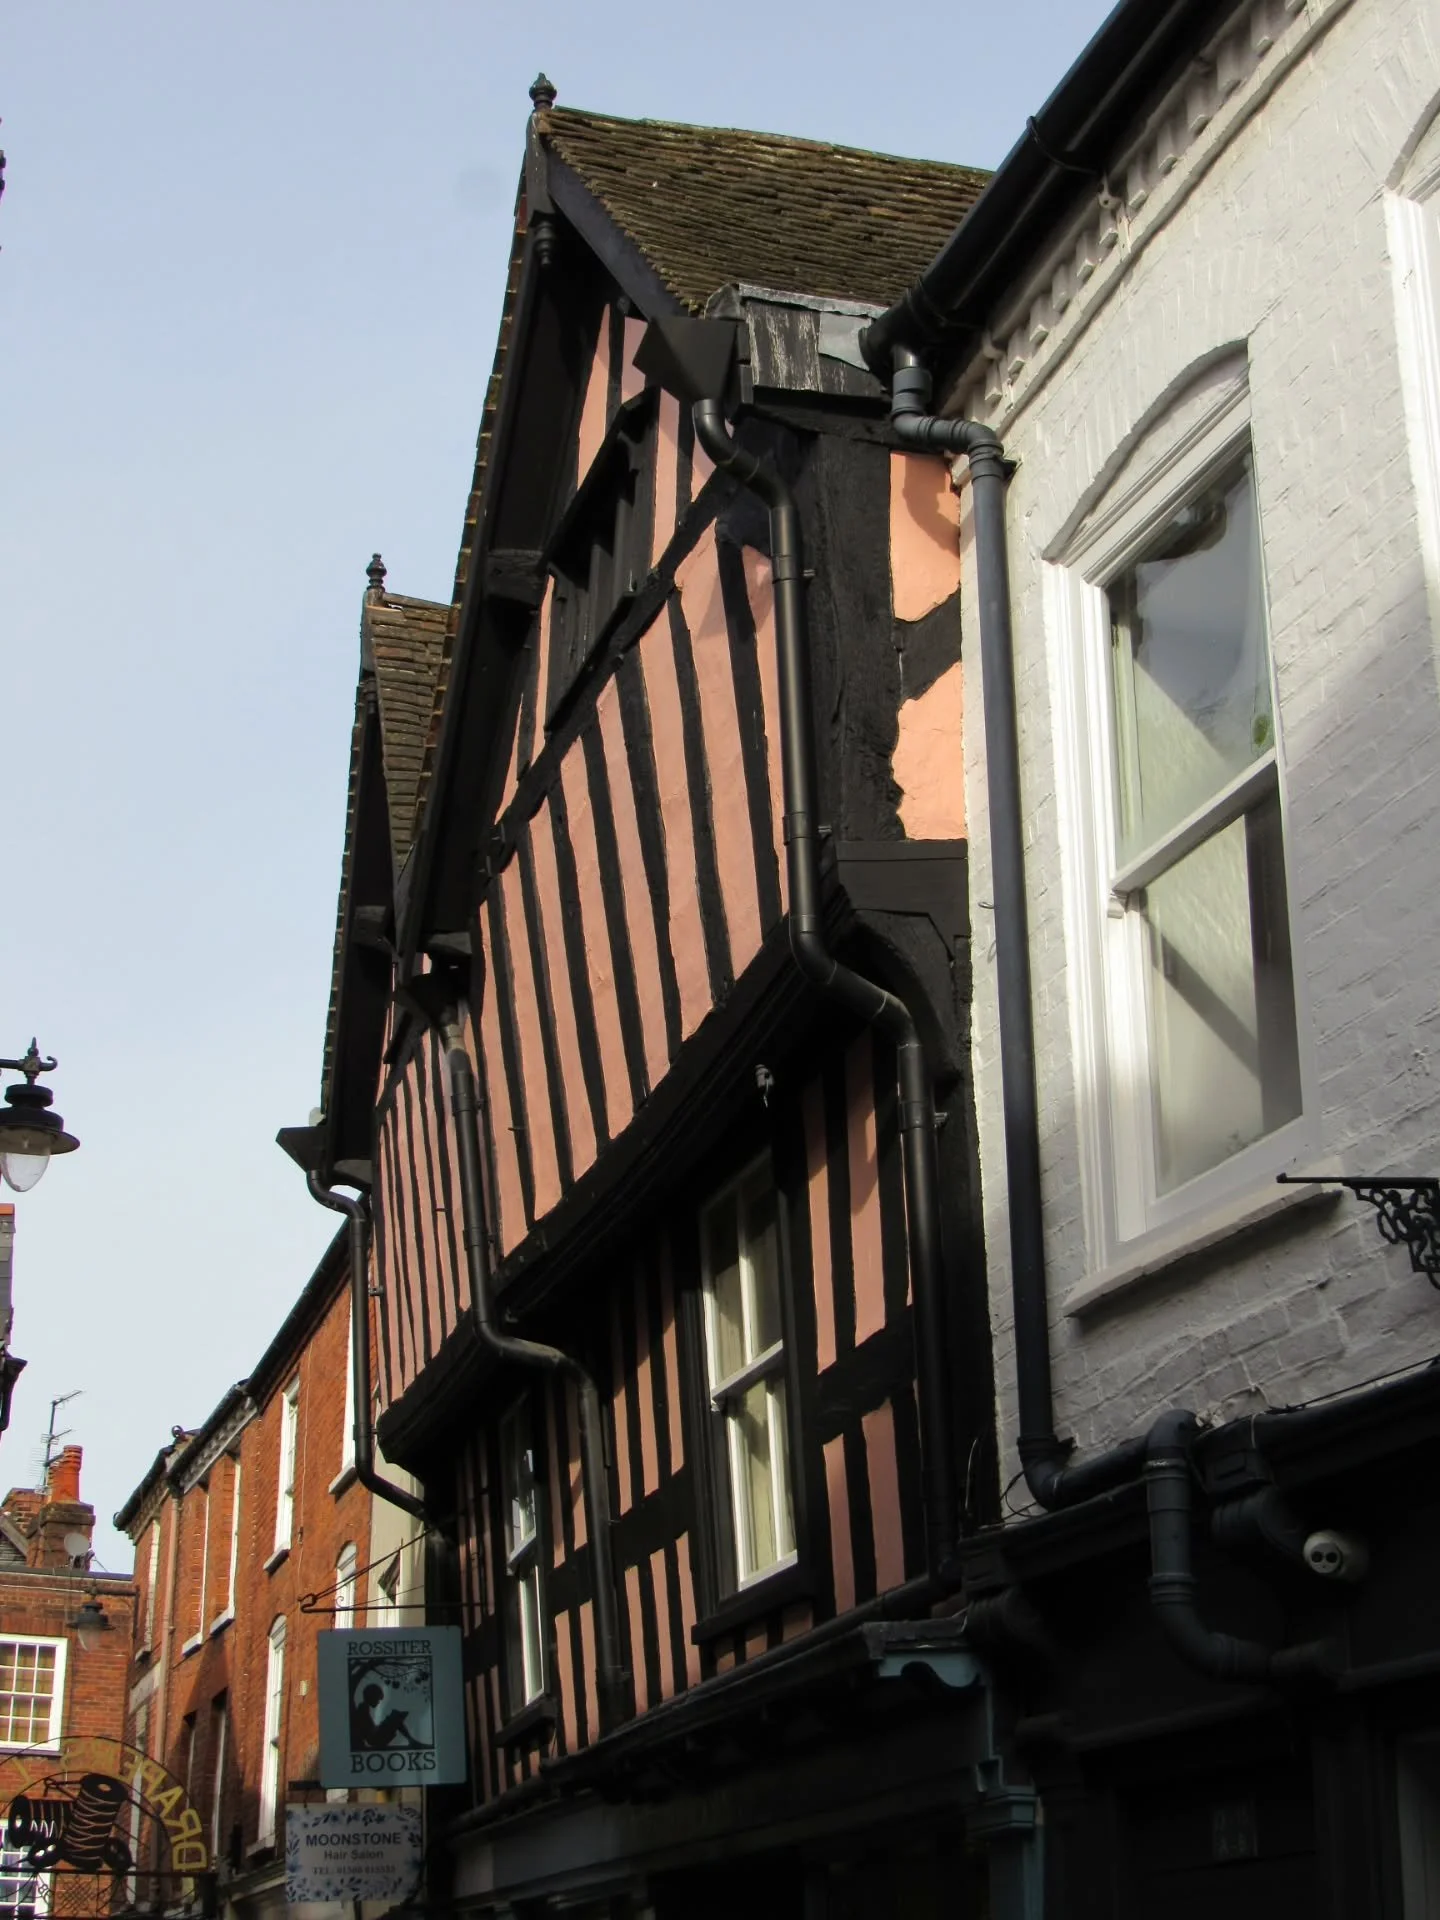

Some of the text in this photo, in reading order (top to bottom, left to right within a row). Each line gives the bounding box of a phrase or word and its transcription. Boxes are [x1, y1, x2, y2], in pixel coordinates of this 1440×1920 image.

[347, 1640, 432, 1655] ROSSITER
[350, 1752, 437, 1773] BOOKS
[306, 1832, 401, 1846] MOONSTONE
[324, 1849, 384, 1861] Hair Salon
